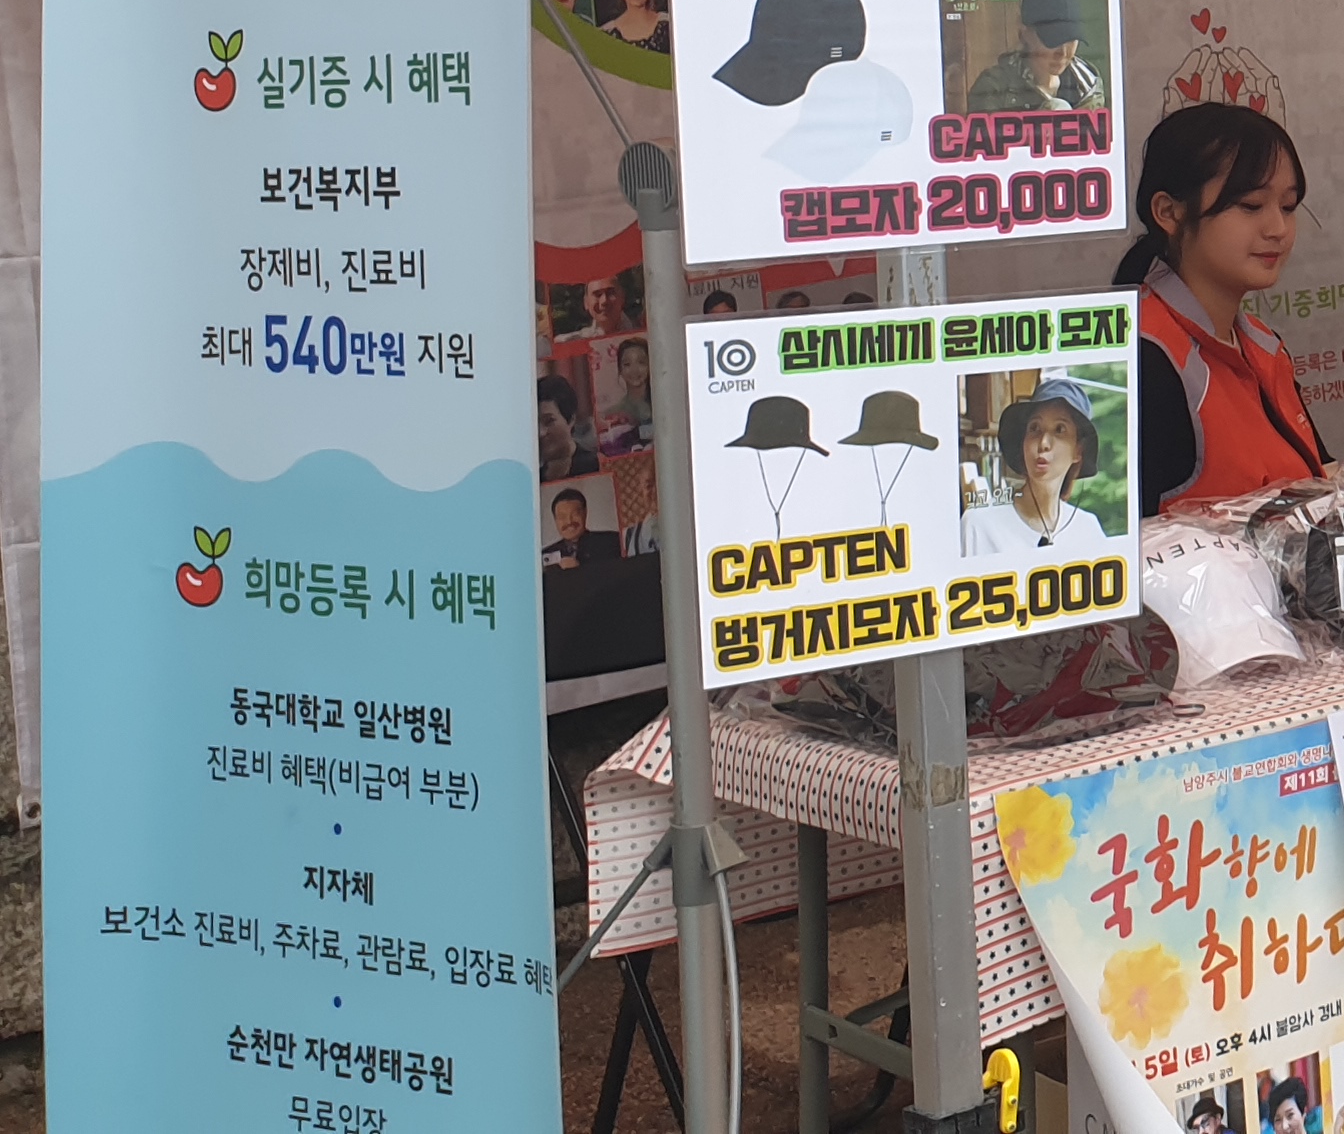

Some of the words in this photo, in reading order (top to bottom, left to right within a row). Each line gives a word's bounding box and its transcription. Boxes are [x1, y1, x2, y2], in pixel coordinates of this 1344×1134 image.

[257, 54, 351, 109] 실기증
[364, 53, 394, 104] 시
[407, 51, 473, 106] 혜택
[931, 112, 1111, 160] CAPTEN
[260, 166, 402, 211] 보건복지부
[783, 186, 920, 240] 캡모자
[929, 171, 1111, 231] 20,000
[240, 246, 331, 293] 장제비,
[341, 248, 427, 293] 진료비
[201, 326, 253, 367] 최대
[264, 314, 406, 377] 540만원
[417, 332, 476, 379] 지원
[780, 319, 934, 372] 삼시세끼
[943, 311, 1053, 357] 윤세아
[1059, 306, 1130, 347] 모자
[708, 379, 756, 394] CAPTEN
[245, 557, 372, 619] 희망등록
[384, 569, 416, 620] 시
[430, 571, 497, 630] 혜택
[710, 527, 908, 596] CAPTEN
[715, 592, 939, 669] 벙거지모자
[948, 559, 1125, 633] 25,000
[230, 687, 345, 732] 동국대학교
[354, 699, 453, 746] 일산병원
[206, 745, 273, 784] 진료비
[419, 767, 480, 812] 부분)
[1183, 769, 1229, 793] 남양주시
[303, 866, 375, 906] 지자체
[100, 905, 187, 941] 보건소
[444, 946, 518, 988] 입장료
[227, 1023, 297, 1070] 순천만
[305, 1035, 455, 1097] 자연생태공원
[1185, 1042, 1211, 1068] (토)
[1215, 1032, 1244, 1057] 오후
[1248, 1022, 1272, 1045] 4시
[1275, 1009, 1315, 1038] 불암사
[1318, 998, 1343, 1022] 경내
[288, 1095, 388, 1134] 무료입장
